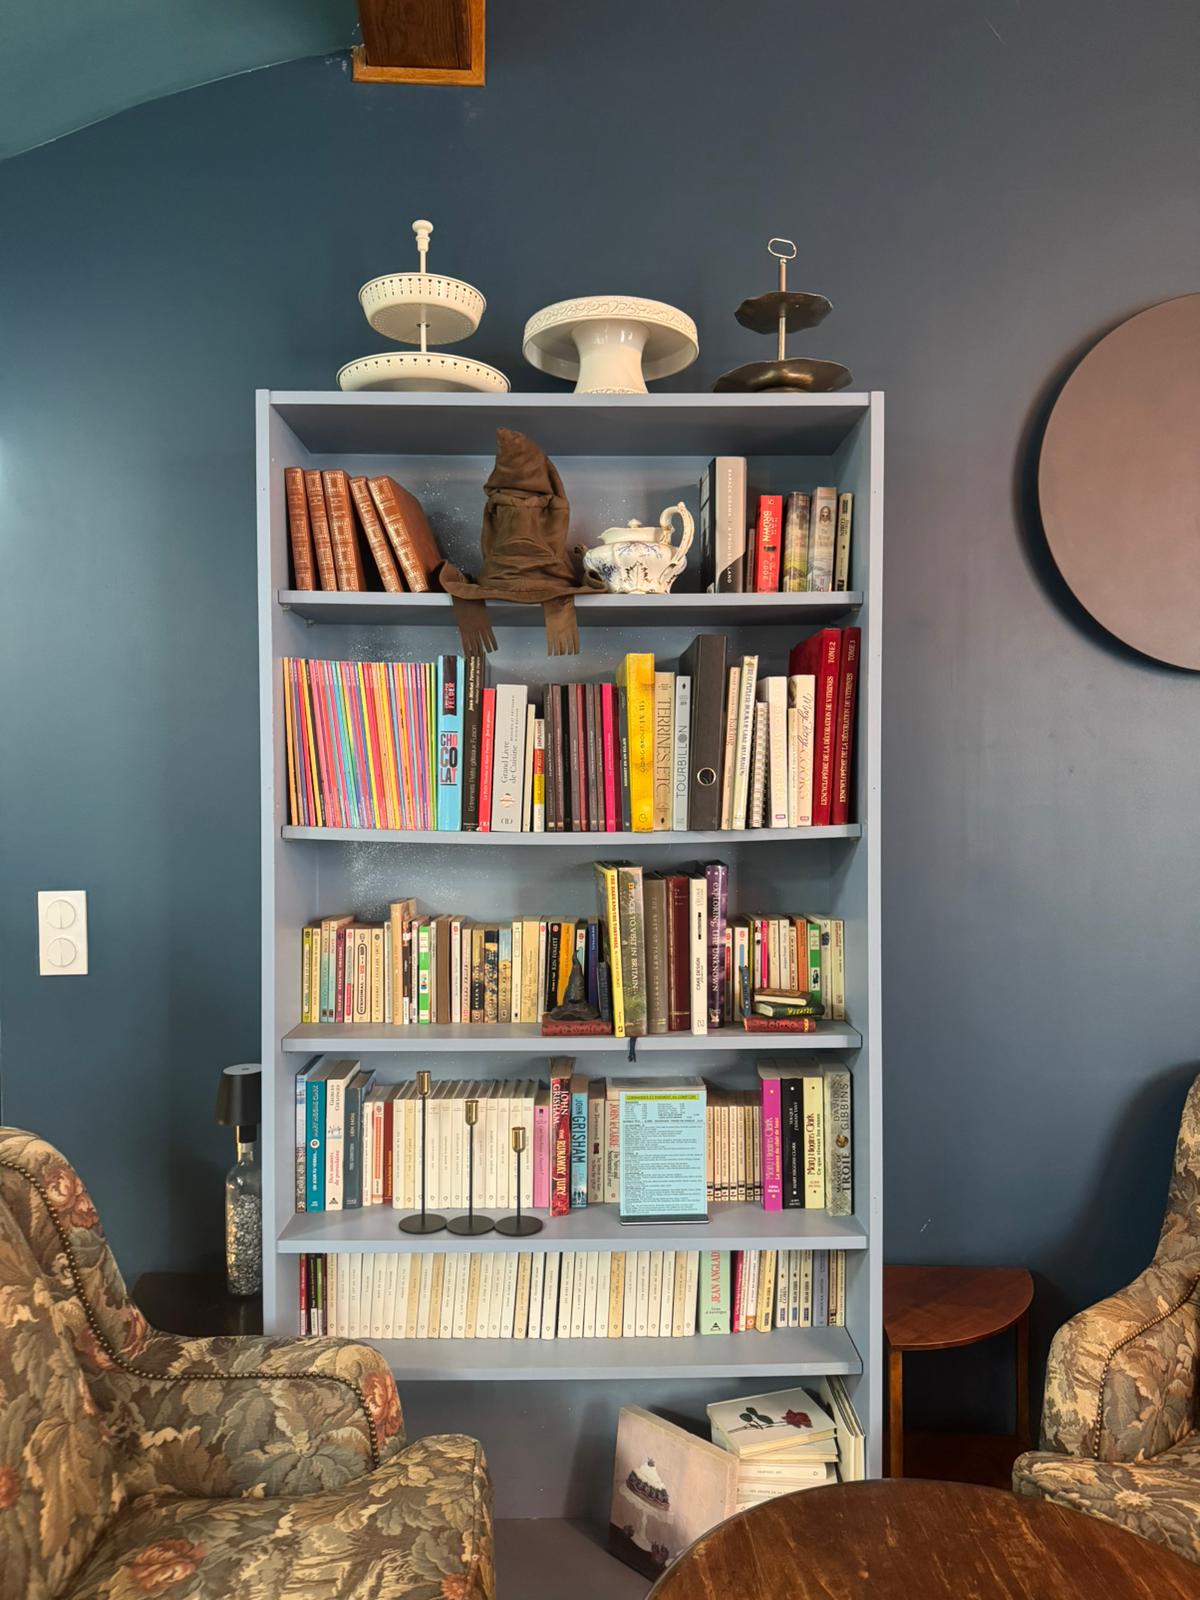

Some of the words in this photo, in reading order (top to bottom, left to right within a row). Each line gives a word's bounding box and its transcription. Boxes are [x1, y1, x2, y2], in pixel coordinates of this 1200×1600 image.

[762, 510, 772, 542] BROWN
[828, 647, 836, 664] TOME
[826, 676, 834, 703] VITRINES
[845, 673, 853, 699] VITRINES
[825, 703, 832, 711] DE
[501, 741, 509, 759] Livre
[500, 760, 508, 784] Grand
[676, 725, 688, 799] TOURBILLON
[440, 768, 458, 784] LAT
[510, 775, 516, 784] de
[630, 916, 636, 925] TO
[630, 927, 638, 946] VISIT
[630, 948, 638, 956] IN
[631, 958, 639, 989] BRITAIN
[552, 1084, 560, 1125] GRISHAM
[575, 1099, 583, 1115] JOHN
[609, 1104, 619, 1121] JOHN
[840, 1083, 849, 1130] GIBBINS
[765, 1117, 773, 1137] Clark
[806, 1113, 815, 1133] Clark
[572, 1116, 585, 1164] GRISHAM
[807, 1134, 816, 1156] Higgins
[556, 1140, 566, 1174] RUNAWAY
[807, 1158, 816, 1176] Mary
[766, 1162, 774, 1180] Mary
[842, 1154, 850, 1192] TROIE
[553, 1177, 566, 1196] JURY
[711, 1250, 721, 1281] ANGLAD
[711, 1283, 721, 1304] JEAN
